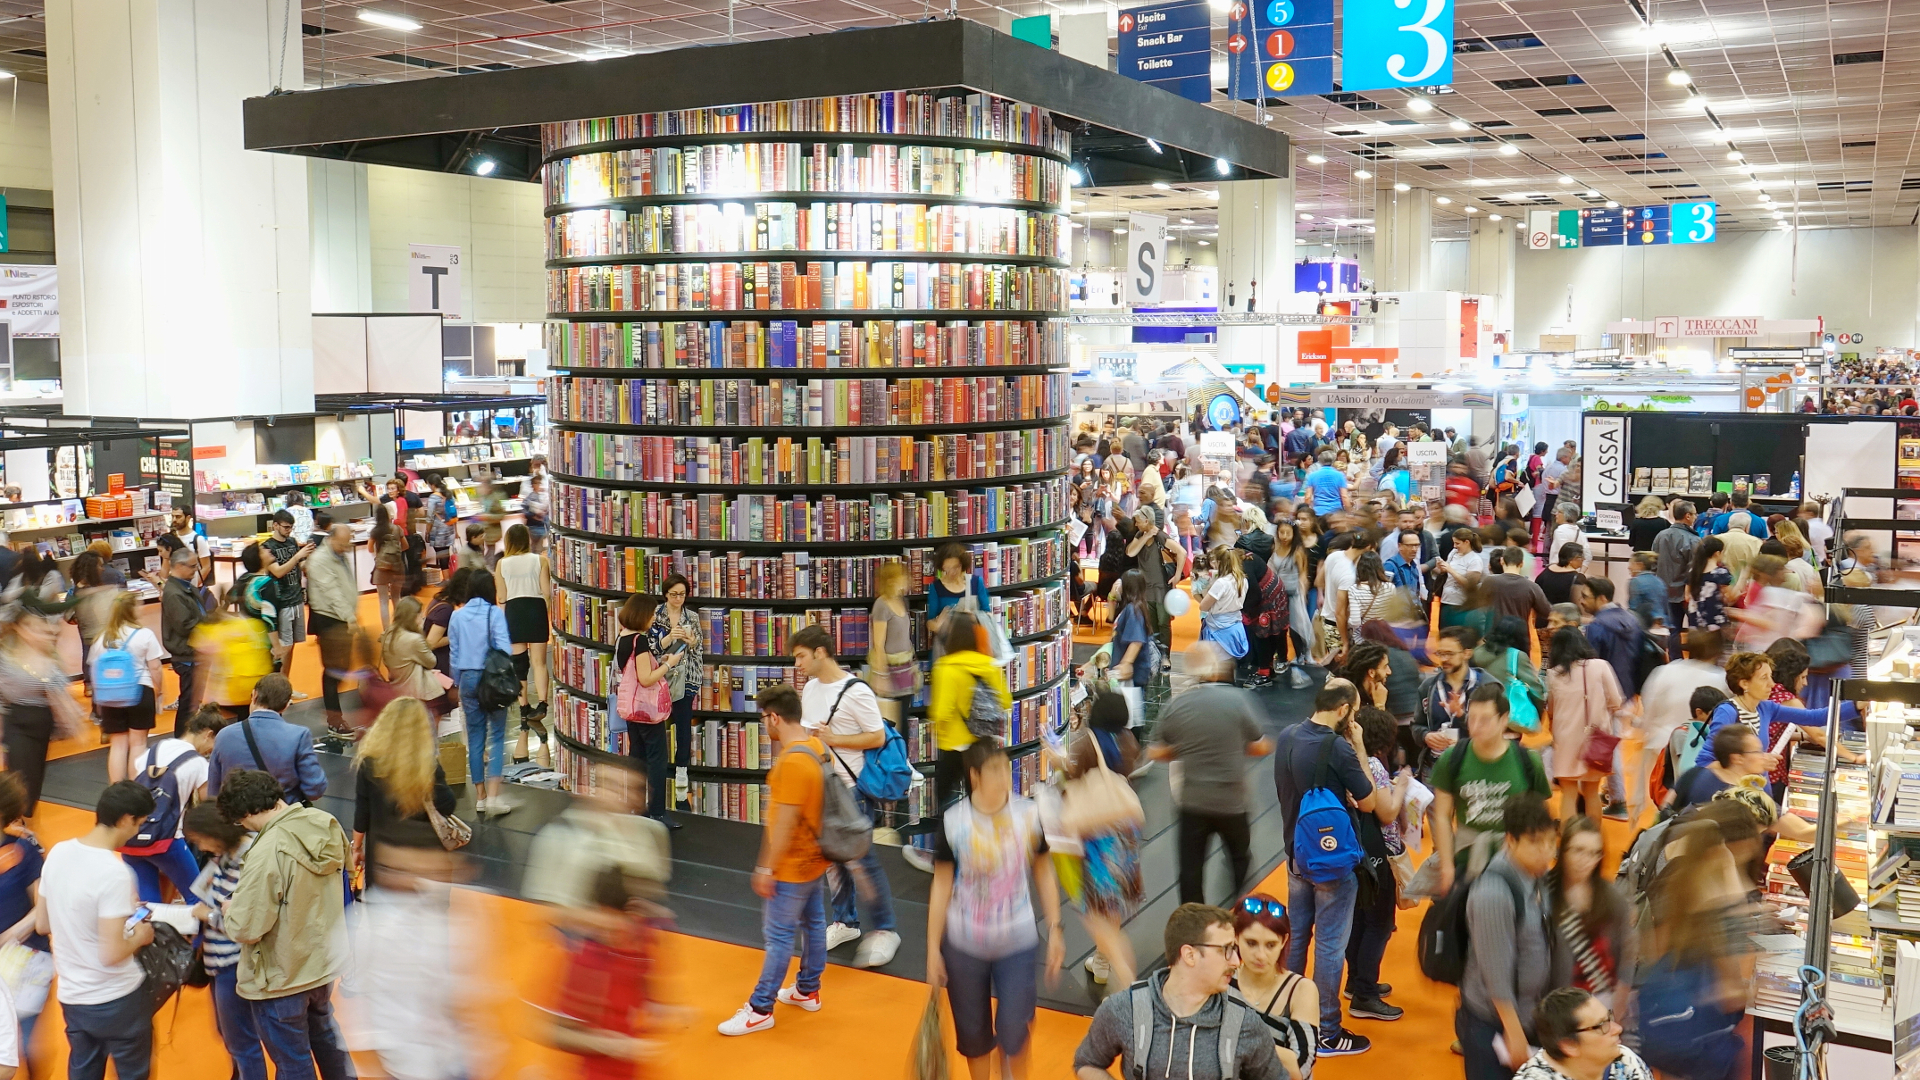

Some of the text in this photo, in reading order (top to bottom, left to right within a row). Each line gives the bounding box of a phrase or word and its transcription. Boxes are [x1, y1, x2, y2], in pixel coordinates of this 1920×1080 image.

[1137, 12, 1166, 23] Uscita
[1275, 1, 1286, 22] 5
[1137, 33, 1183, 47] Snack Bar
[1275, 34, 1286, 56] 1
[1386, 0, 1448, 82] 3
[1137, 58, 1173, 70] Toilette
[1273, 66, 1287, 87] 2
[1644, 210, 1651, 218] 5
[1645, 221, 1651, 230] 1
[1688, 204, 1714, 242] 3
[454, 254, 459, 265] 3
[1136, 241, 1156, 296] S
[422, 265, 448, 310] T
[1685, 318, 1758, 330] TRECCANI
[1301, 352, 1327, 360] Erickson
[1327, 395, 1361, 404] L'Asino
[1363, 394, 1389, 404] d'oro
[1391, 395, 1425, 405] edizioni
[141, 456, 191, 476] CHALENGER
[1598, 428, 1619, 496] CASSA
